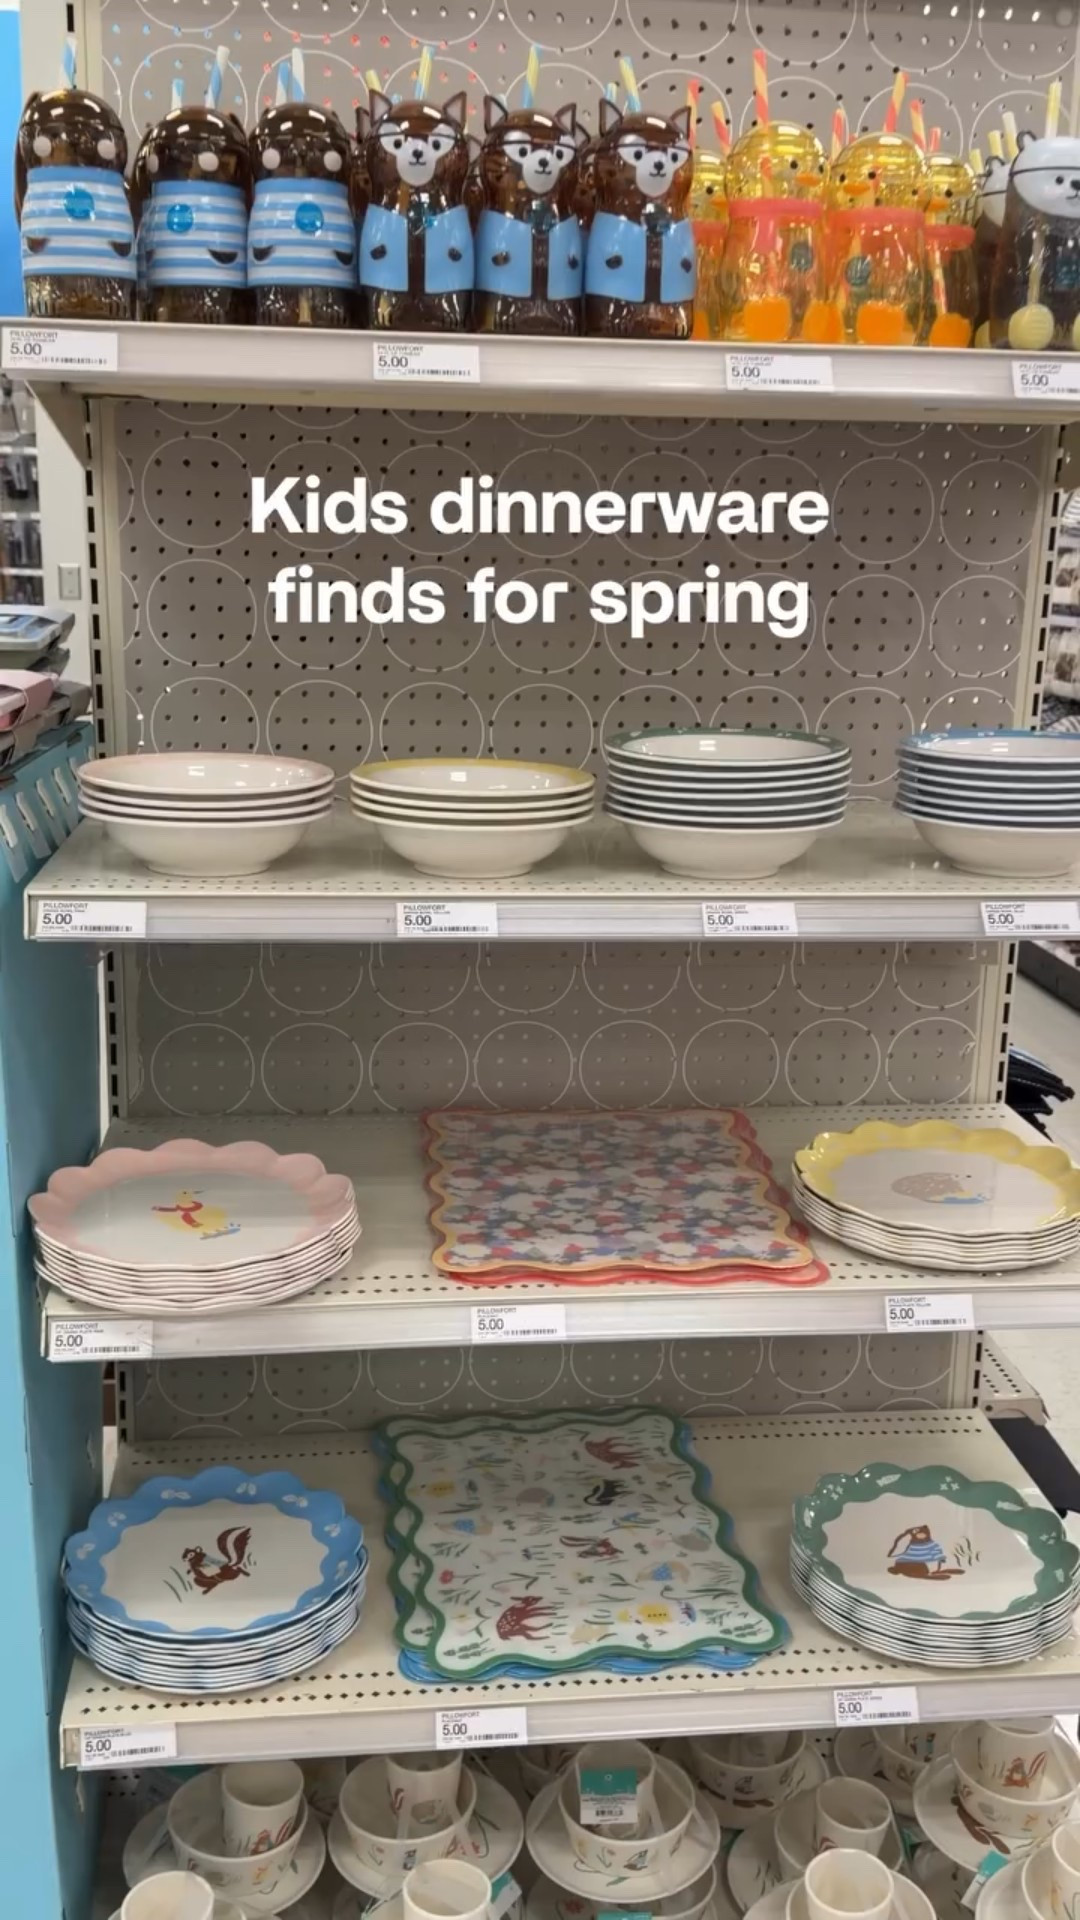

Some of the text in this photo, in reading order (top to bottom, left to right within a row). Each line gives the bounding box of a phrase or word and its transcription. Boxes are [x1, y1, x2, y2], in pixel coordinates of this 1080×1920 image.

[10, 342, 42, 355] 5.00
[378, 355, 408, 368] 5.00
[731, 366, 760, 378] 5.00
[1020, 373, 1049, 386] 5.00
[42, 913, 73, 925] 5.00
[404, 914, 432, 926] 5.00
[707, 914, 734, 926] 5.00
[987, 913, 1015, 925] 5.00
[889, 1307, 915, 1320] 5.00
[478, 1318, 504, 1331] 5.00
[55, 1334, 83, 1347] 5.00
[838, 1701, 863, 1714] 5.00
[442, 1723, 468, 1736] 5.00
[85, 1739, 112, 1753] 5.00
